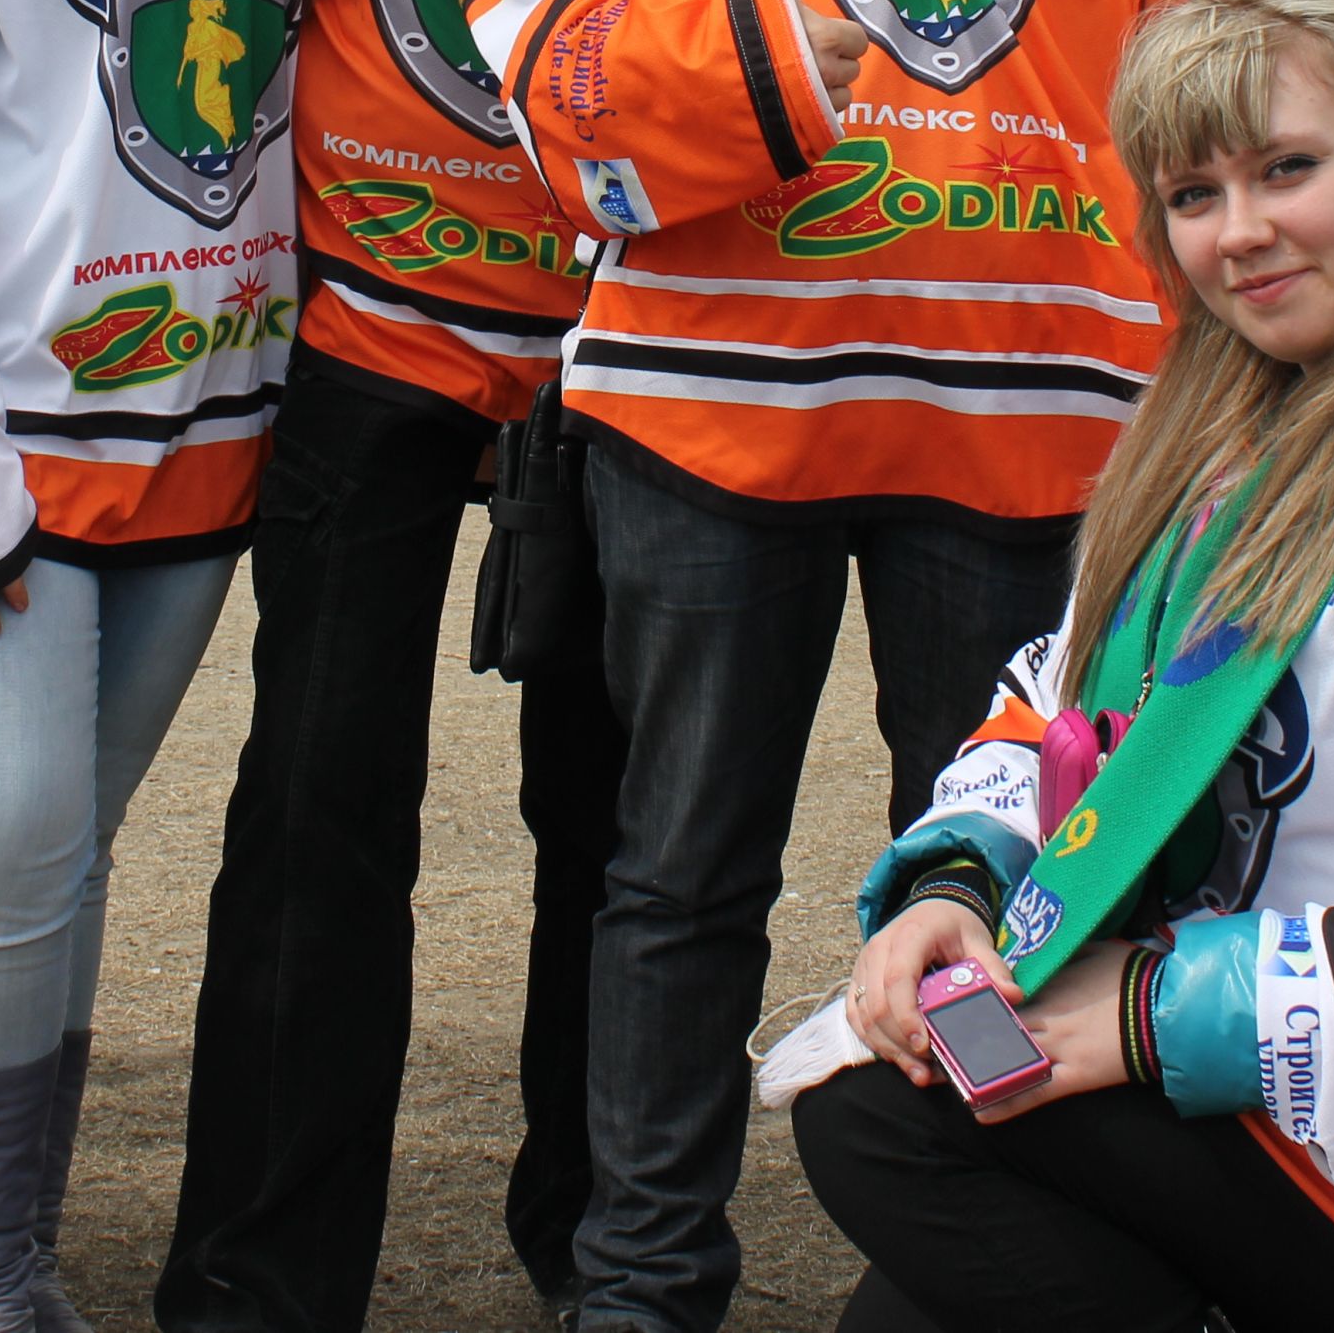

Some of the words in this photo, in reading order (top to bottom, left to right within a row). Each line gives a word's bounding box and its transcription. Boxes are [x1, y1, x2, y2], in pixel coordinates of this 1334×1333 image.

[838, 102, 976, 133] плекс
[317, 179, 590, 280] ZODI
[775, 136, 1120, 259] ZODIAK
